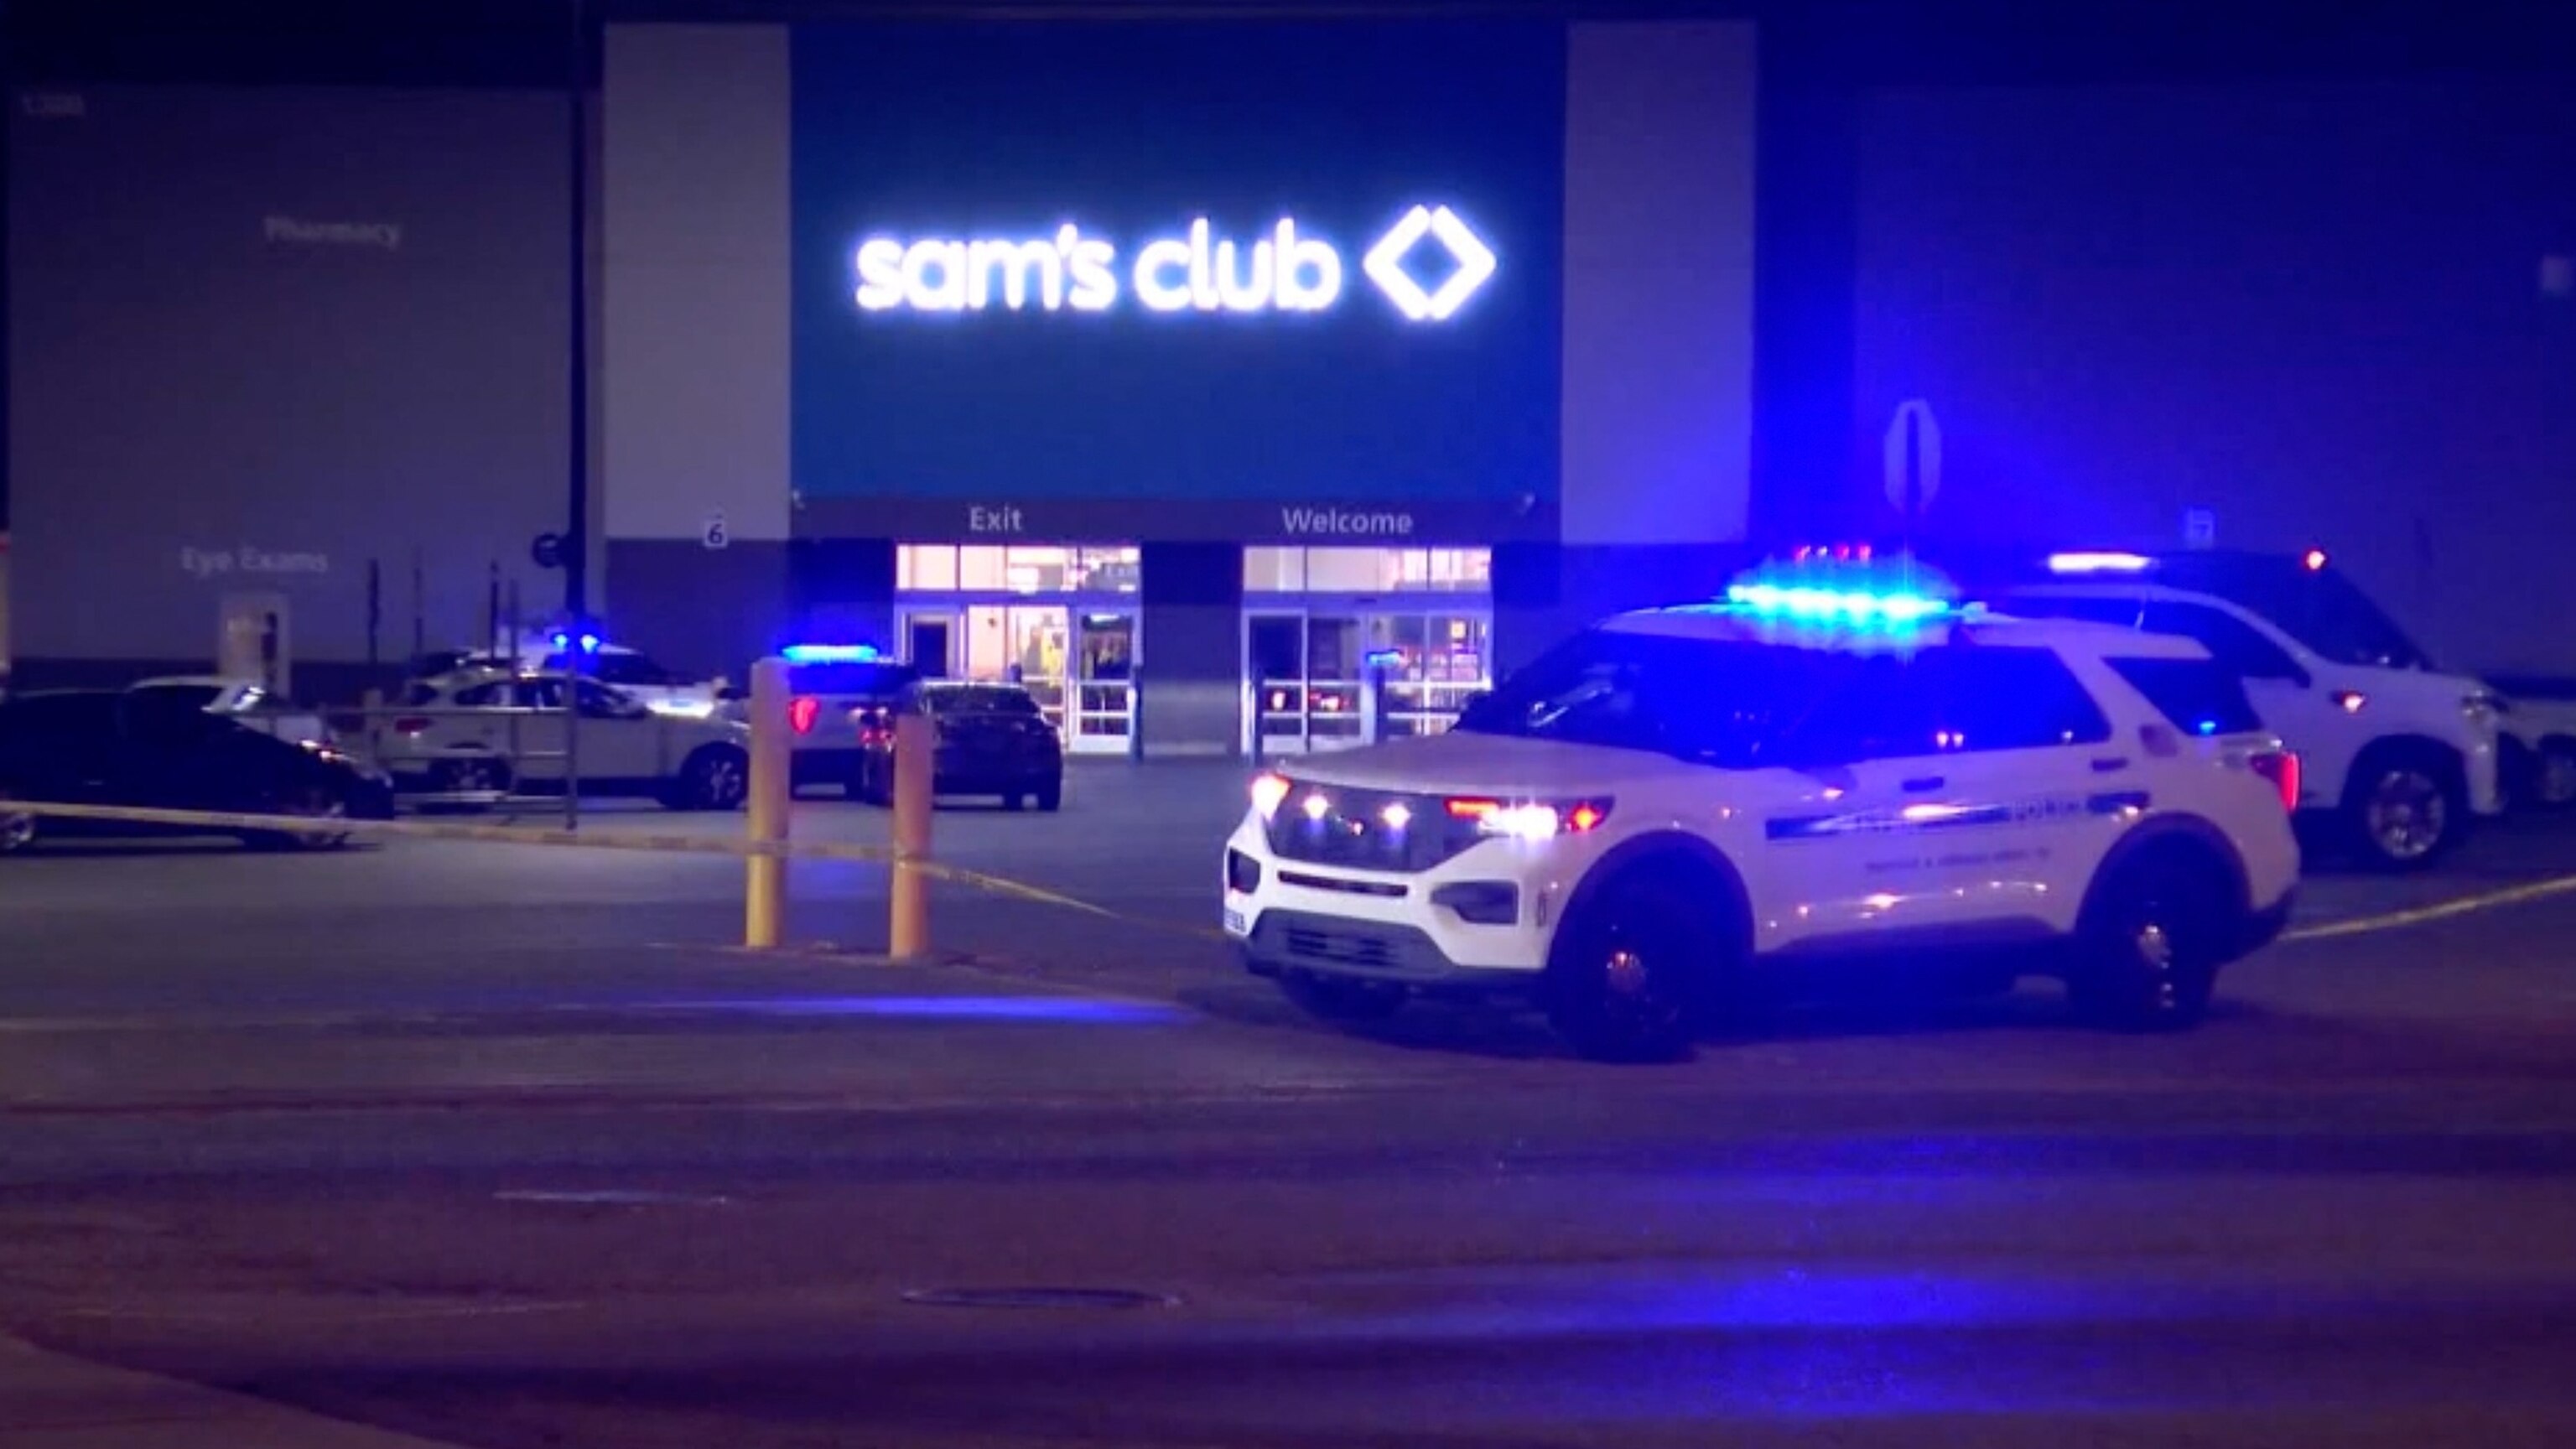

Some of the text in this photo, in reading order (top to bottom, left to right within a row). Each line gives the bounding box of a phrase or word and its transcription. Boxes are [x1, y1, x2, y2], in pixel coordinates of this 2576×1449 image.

[264, 216, 399, 251] Pharmacy
[856, 216, 1342, 310] sam's club
[707, 522, 723, 544] 6
[970, 505, 1022, 532] Exit
[1282, 506, 1414, 534] Welcome
[182, 547, 329, 579] Eye Exams
